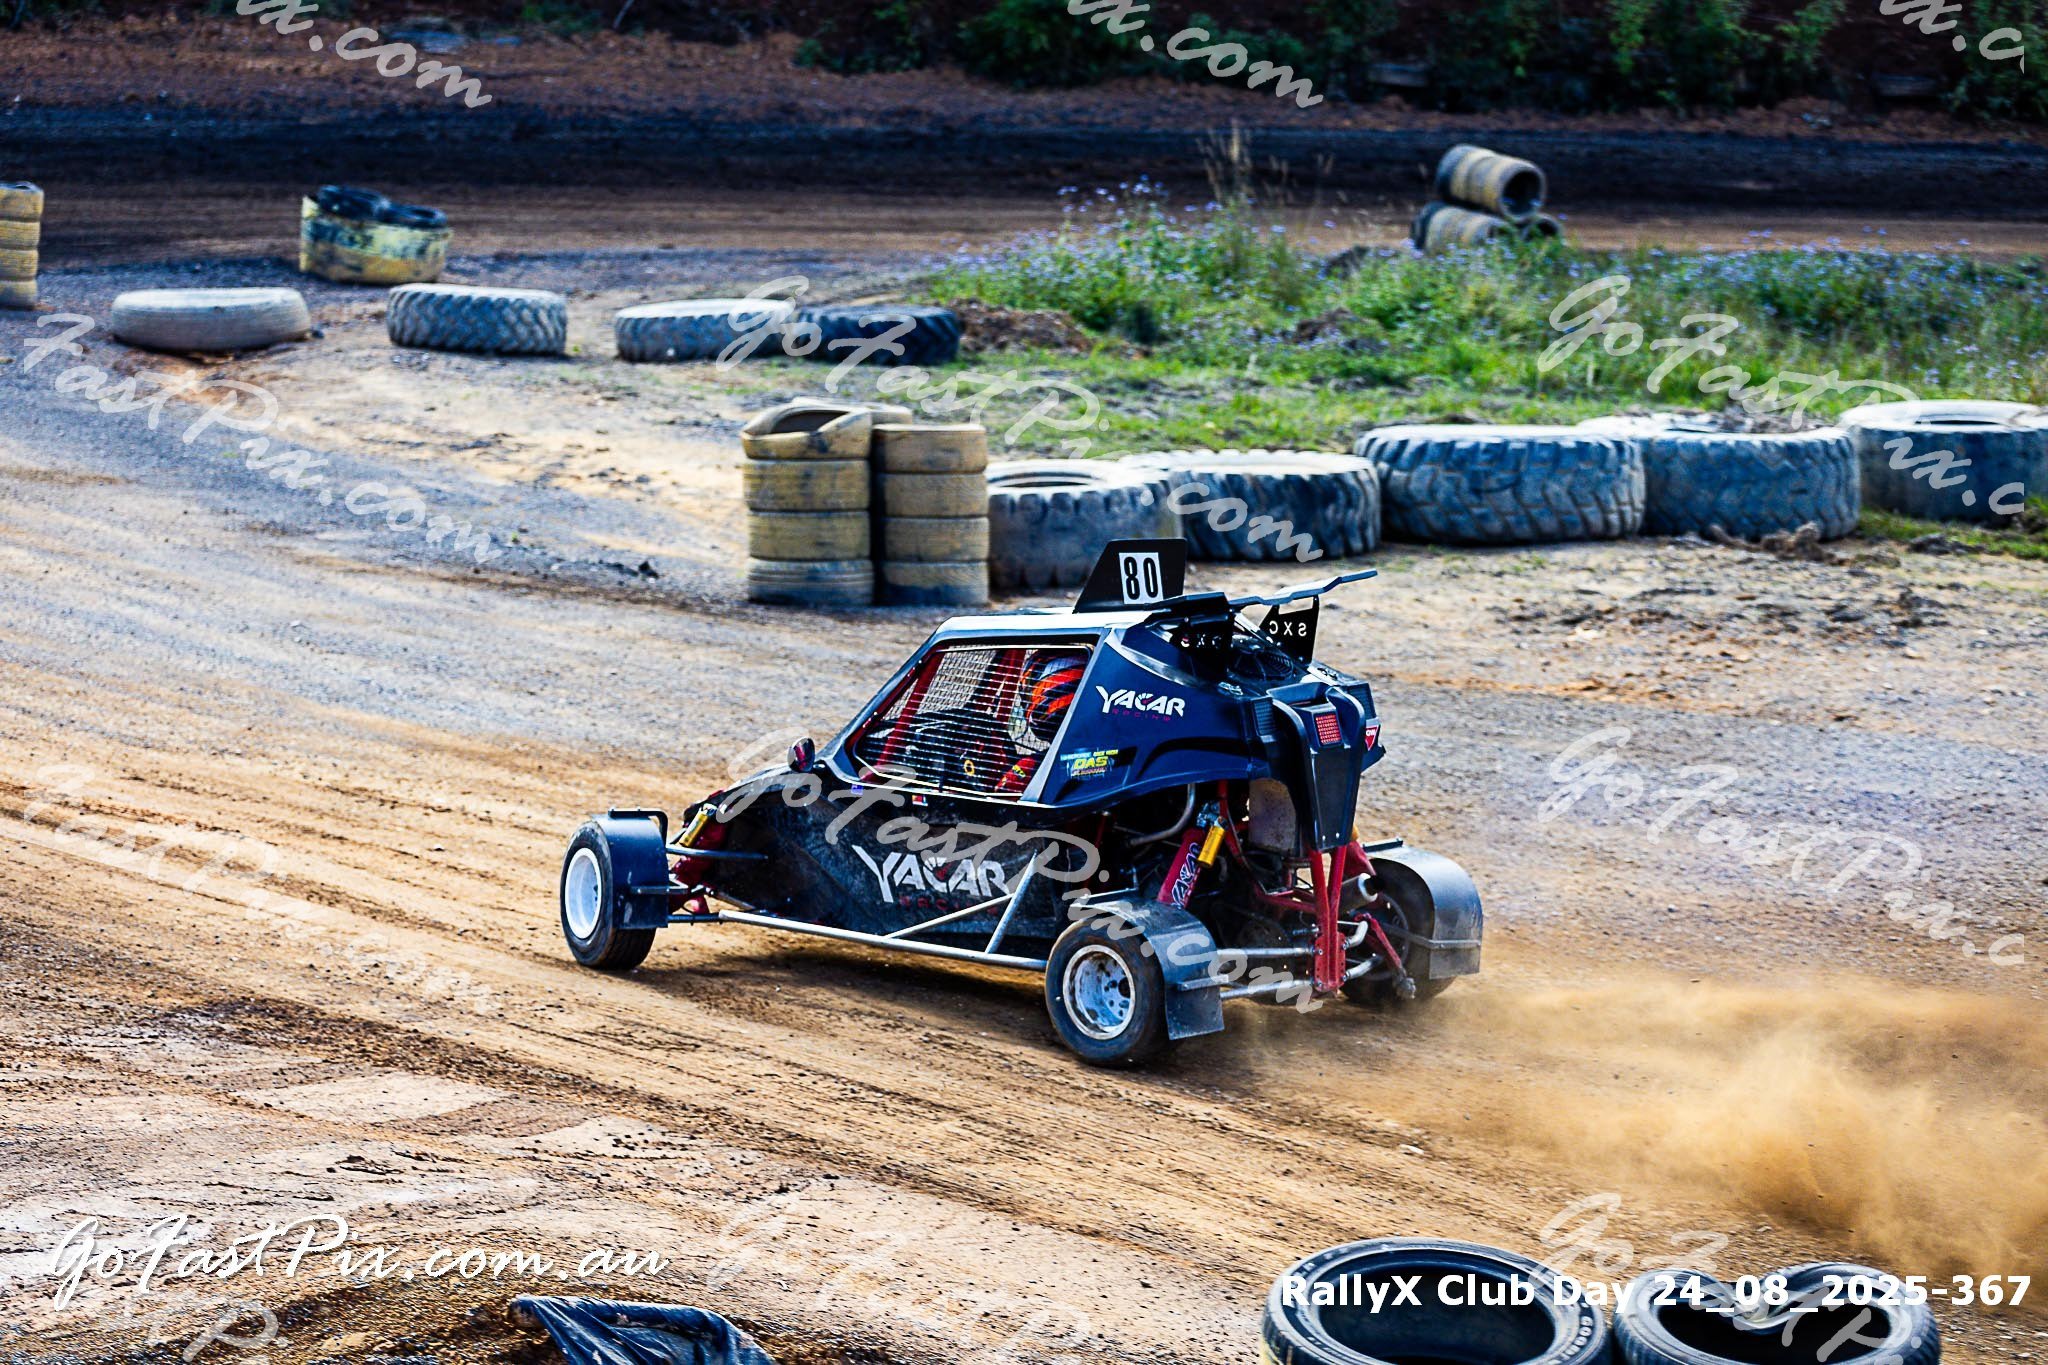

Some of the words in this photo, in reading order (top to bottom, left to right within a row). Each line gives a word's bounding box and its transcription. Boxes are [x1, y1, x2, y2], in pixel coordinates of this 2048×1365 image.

[1123, 556, 1159, 601] 80
[1095, 685, 1186, 717] YACAR
[851, 844, 1010, 904] YACAR
